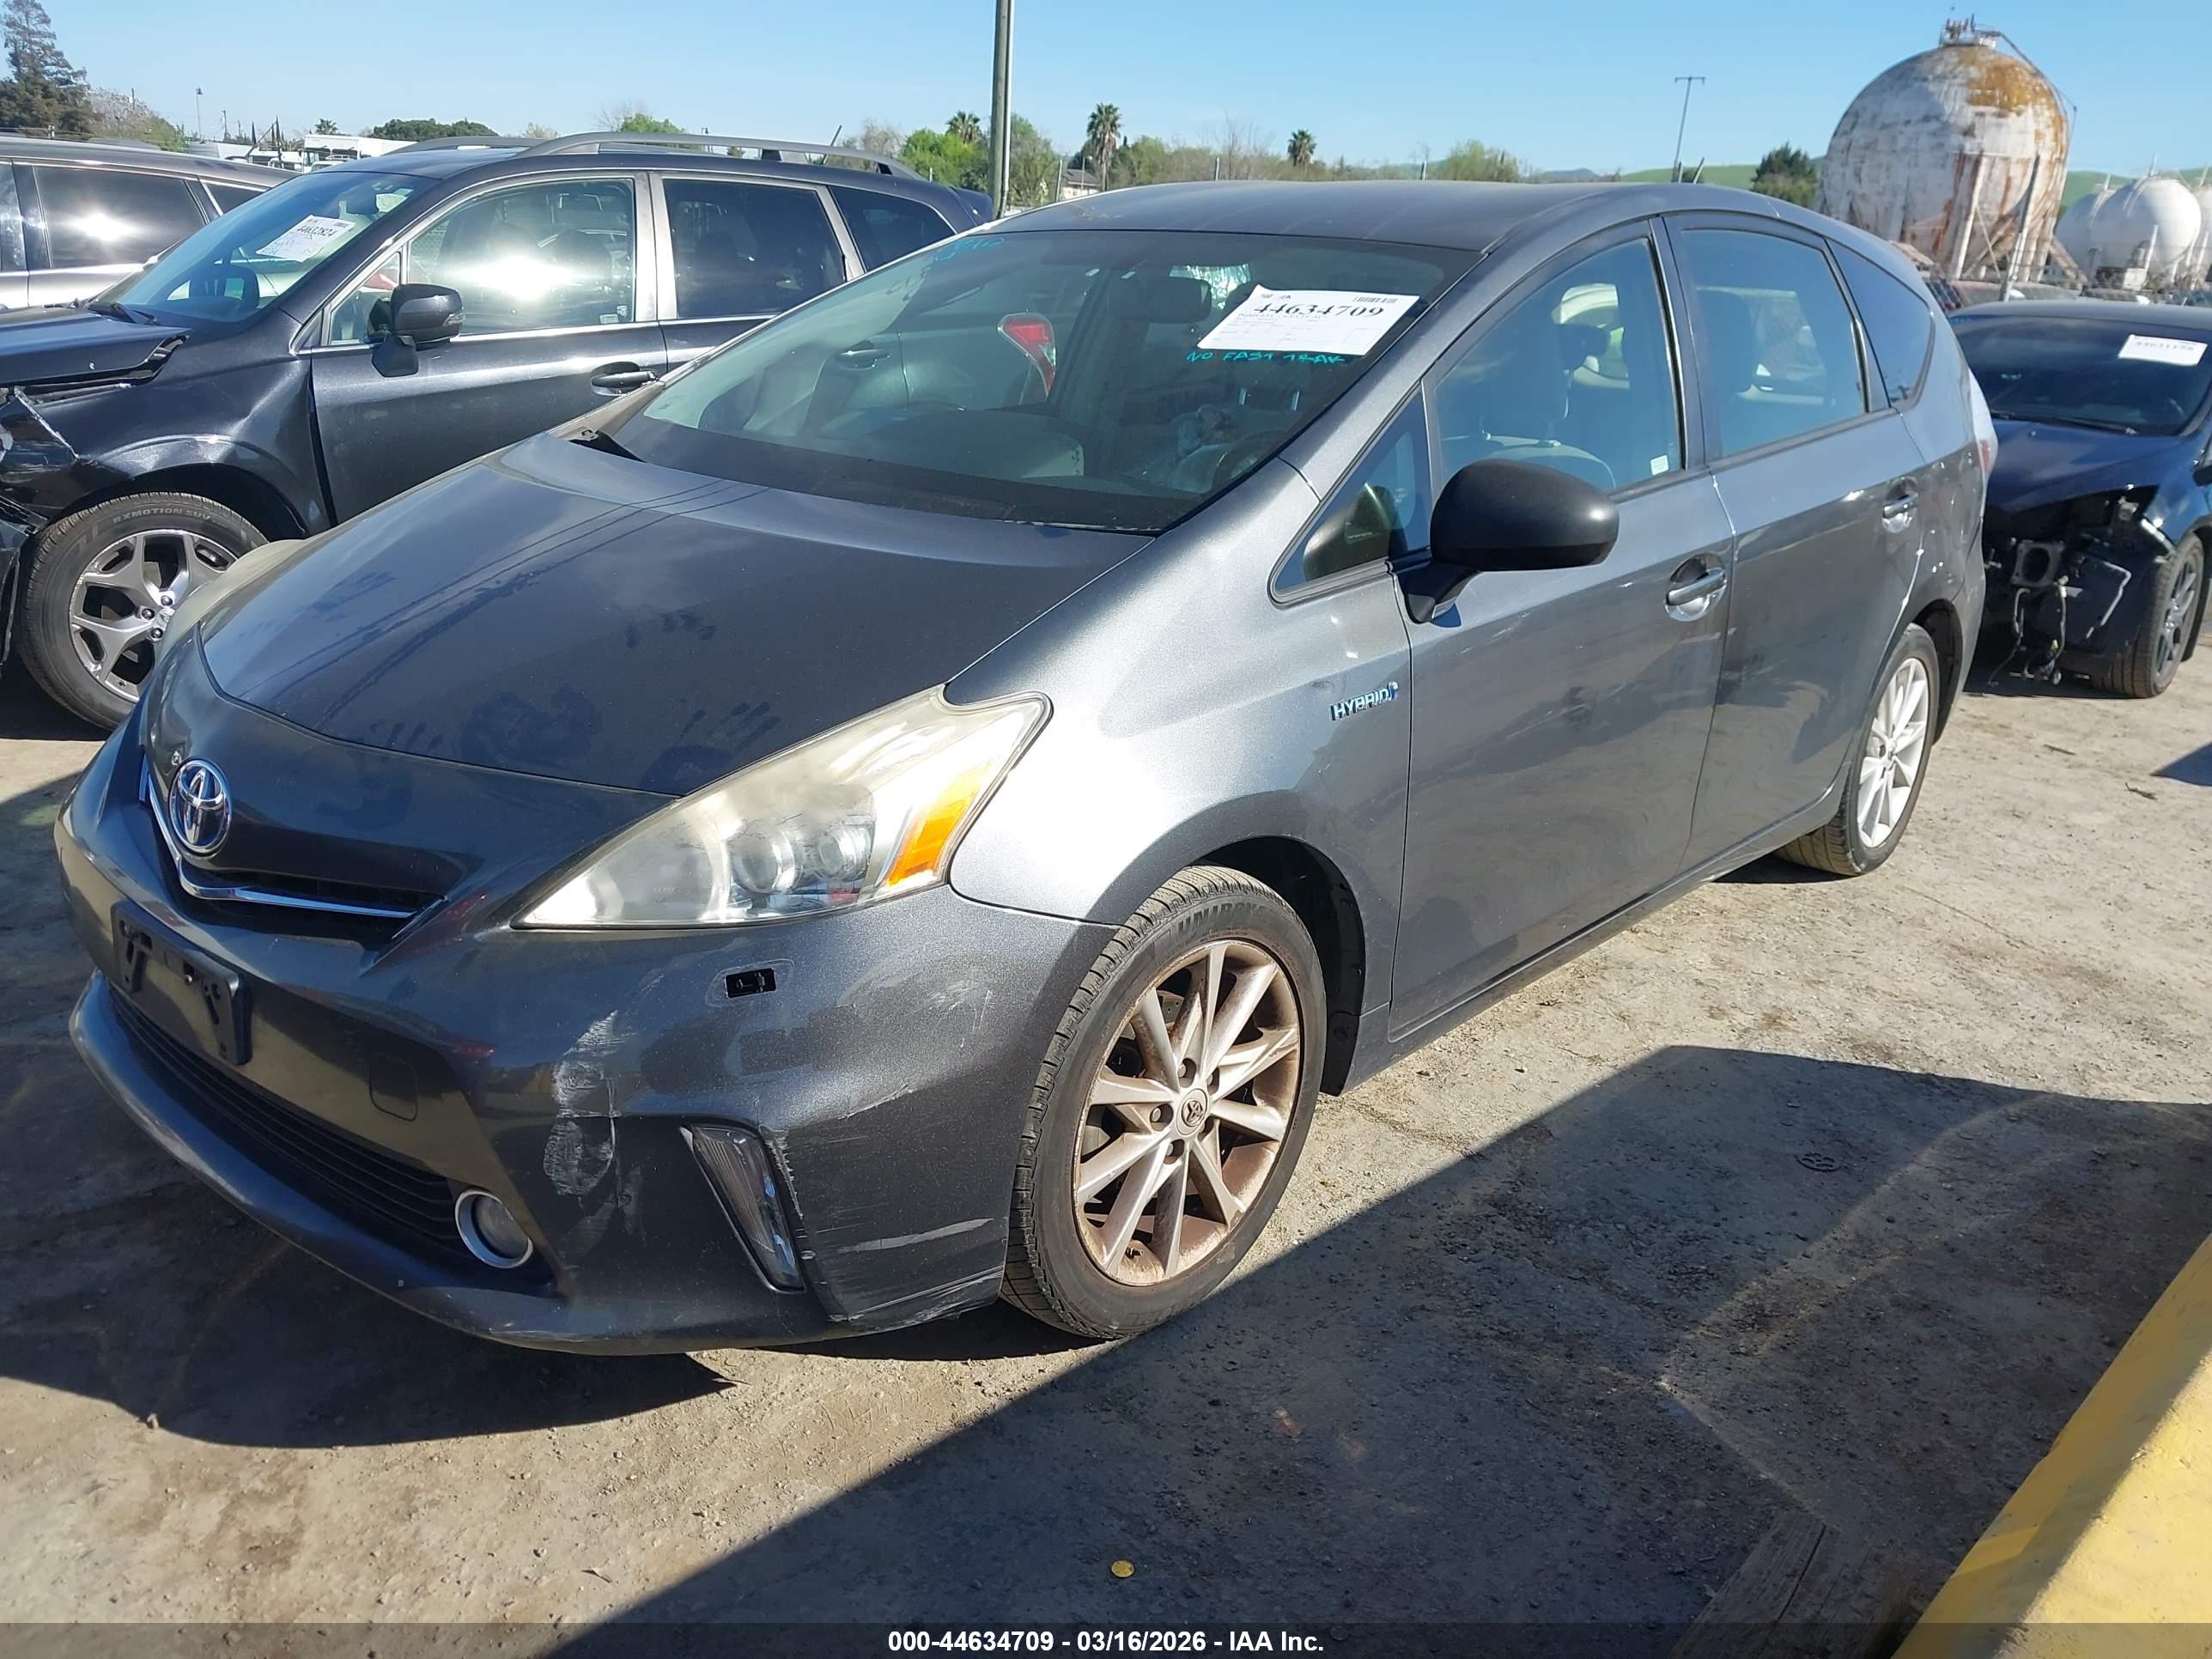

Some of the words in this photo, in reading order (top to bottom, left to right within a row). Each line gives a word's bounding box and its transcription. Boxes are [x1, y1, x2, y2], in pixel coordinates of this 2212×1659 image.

[1253, 303, 1385, 317] 44634709
[1186, 350, 1213, 362] NO
[1222, 352, 1274, 362] FAST
[112, 507, 183, 524] RXMOTION
[185, 509, 211, 520] SUV
[1329, 688, 1389, 721] HYBRID
